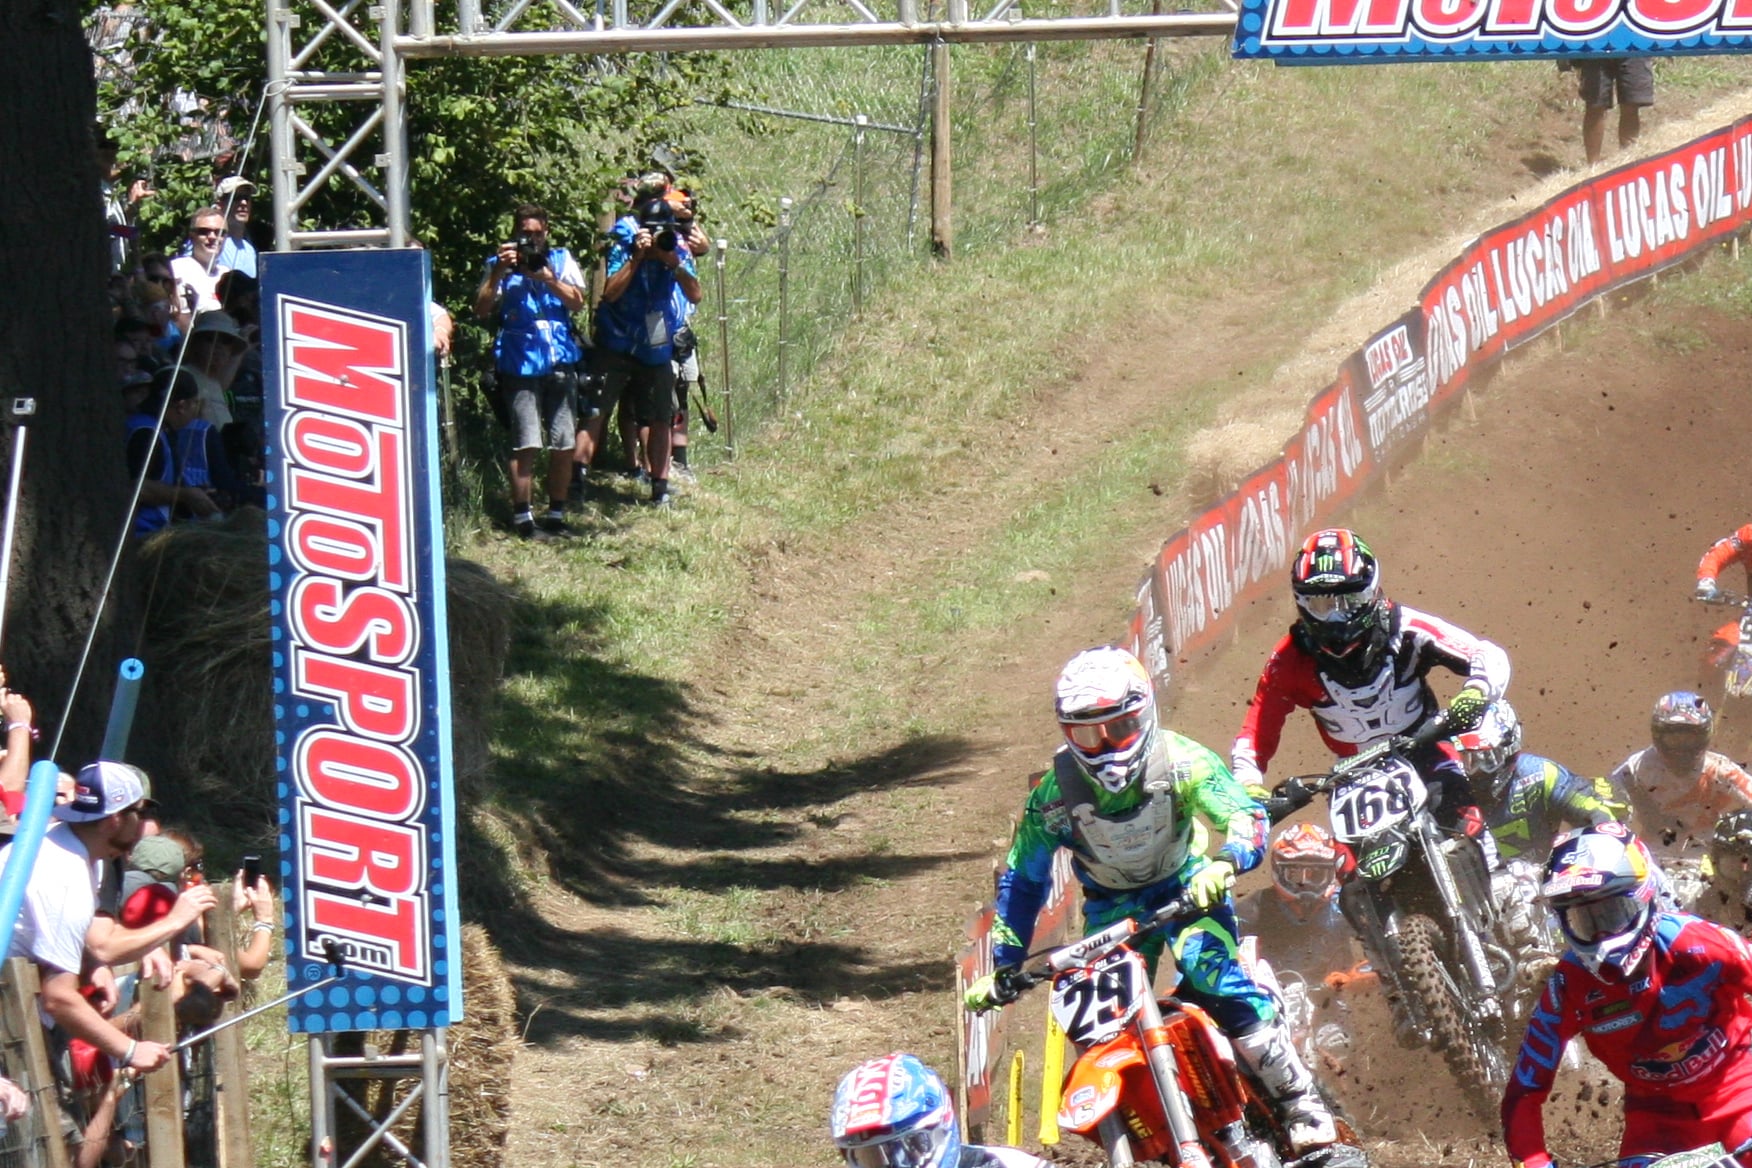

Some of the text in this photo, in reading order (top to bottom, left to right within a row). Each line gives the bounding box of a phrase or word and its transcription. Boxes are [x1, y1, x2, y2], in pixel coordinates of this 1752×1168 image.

[1605, 147, 1733, 263] LUCAS OIL
[1462, 261, 1498, 351] OIL
[1491, 215, 1568, 323] LUCAS
[277, 293, 432, 988] MOTOSPORT
[1336, 772, 1414, 836] 168
[1063, 961, 1134, 1042] 29
[1592, 1014, 1638, 1034] MOTOREX
[1629, 977, 1651, 994] FOX
[1515, 1003, 1562, 1088] FOX
[1631, 1058, 1683, 1083] Red
[1680, 1028, 1728, 1079] Bull
